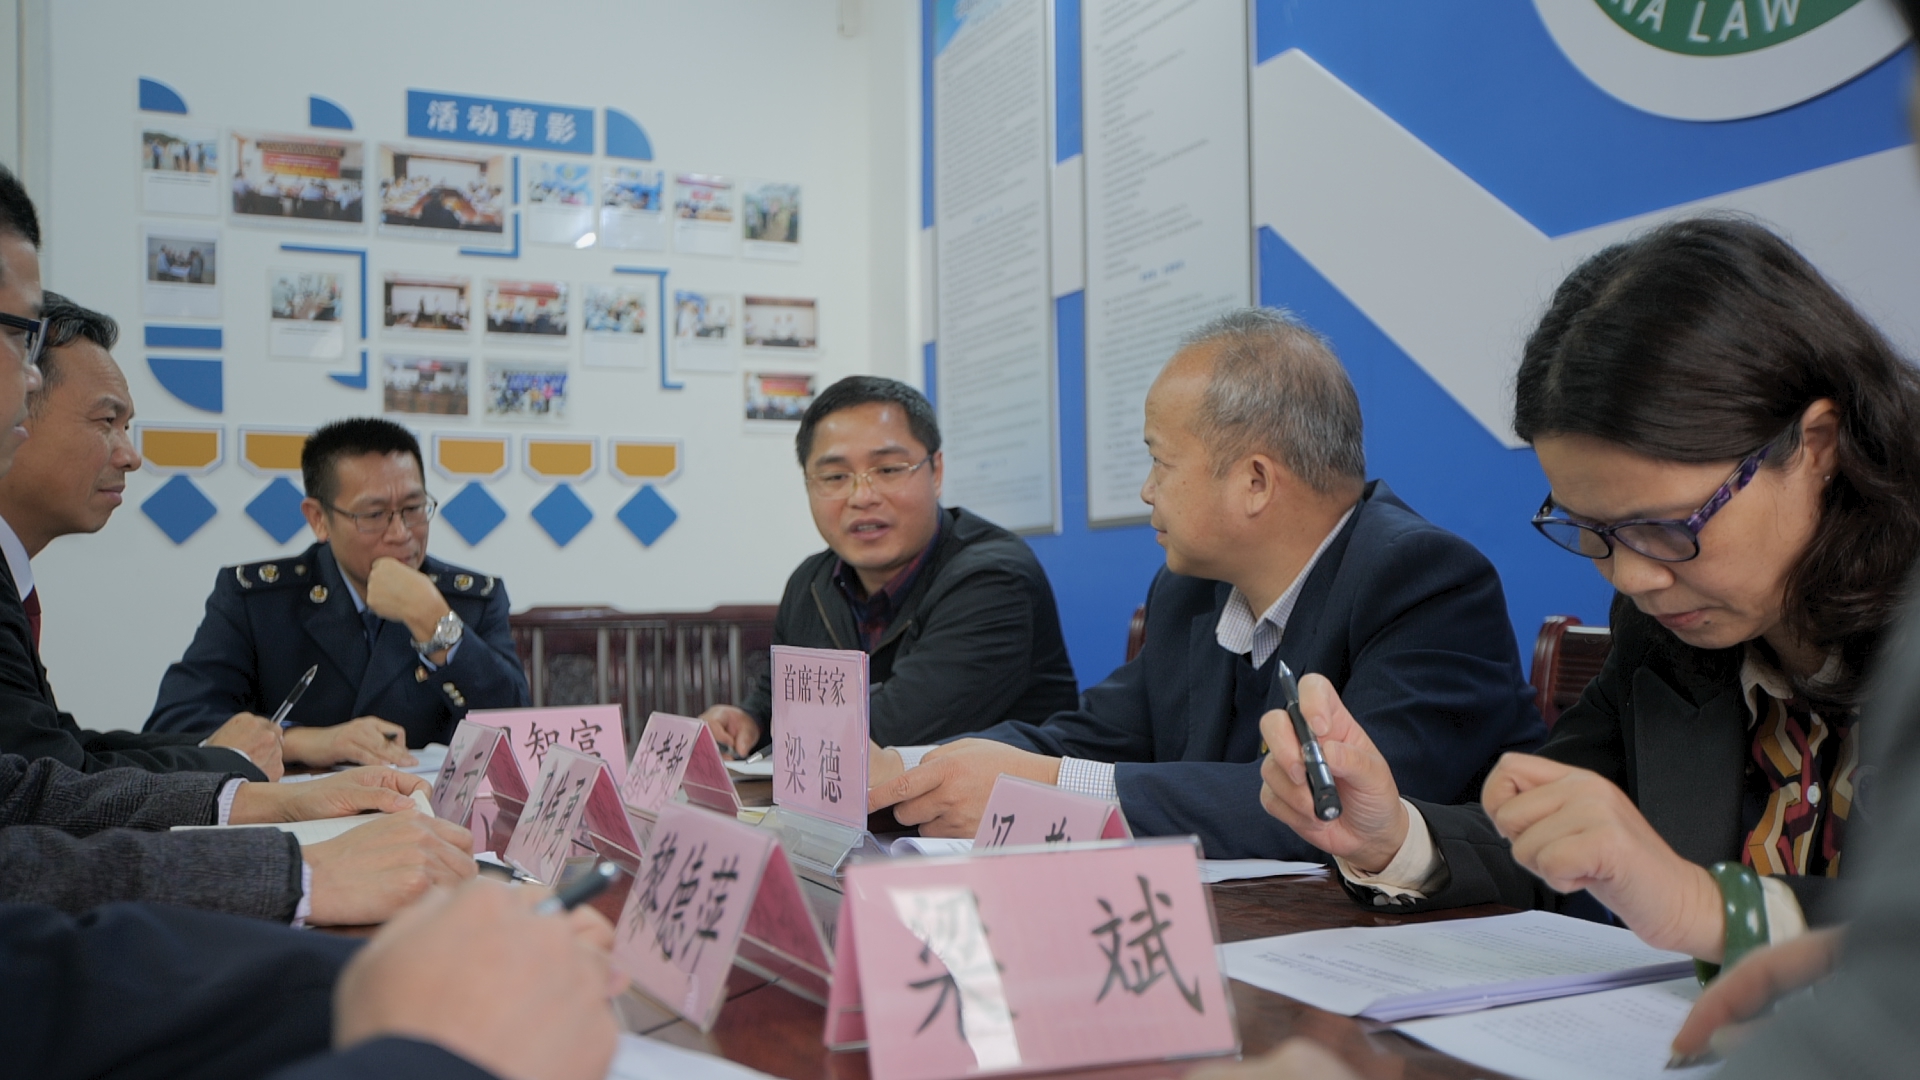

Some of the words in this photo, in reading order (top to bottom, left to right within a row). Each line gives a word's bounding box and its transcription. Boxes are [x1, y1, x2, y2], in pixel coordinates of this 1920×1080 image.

[1686, 0, 1799, 43] LAW
[427, 99, 577, 144] 活动剪影
[782, 663, 846, 708] 首席专家
[500, 718, 603, 771] 智富
[784, 732, 843, 804] 梁德
[627, 831, 740, 985] 黎德萍
